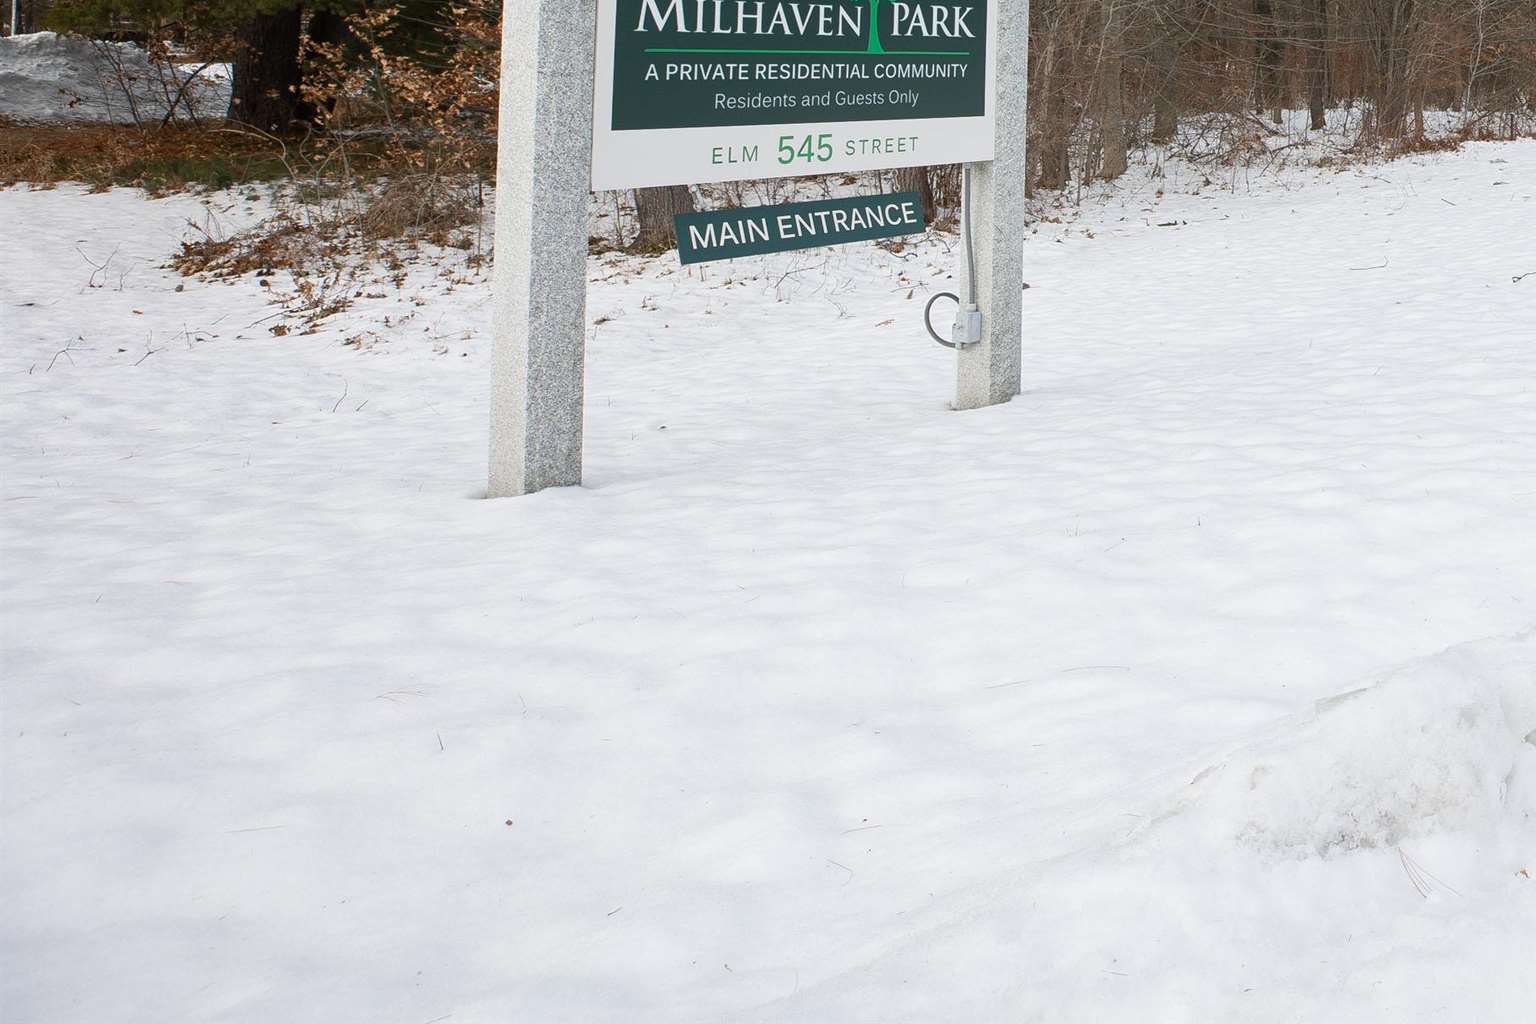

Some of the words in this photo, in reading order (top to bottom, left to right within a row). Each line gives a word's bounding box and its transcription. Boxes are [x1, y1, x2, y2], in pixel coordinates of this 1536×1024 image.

[890, 1, 976, 38] PARK
[645, 64, 659, 81] A
[666, 63, 748, 81] PRIVATE
[756, 63, 869, 80] RESIDENTIAL
[874, 63, 968, 79] COMMUNITY
[714, 92, 796, 110] Residents
[801, 91, 830, 107] and
[835, 90, 884, 106] Guests
[888, 89, 919, 108] Only
[711, 144, 759, 165] ELM
[777, 133, 833, 165] 545
[845, 136, 919, 156] STREET
[688, 217, 770, 250] MAIN
[777, 202, 918, 239] ENTRANCE
